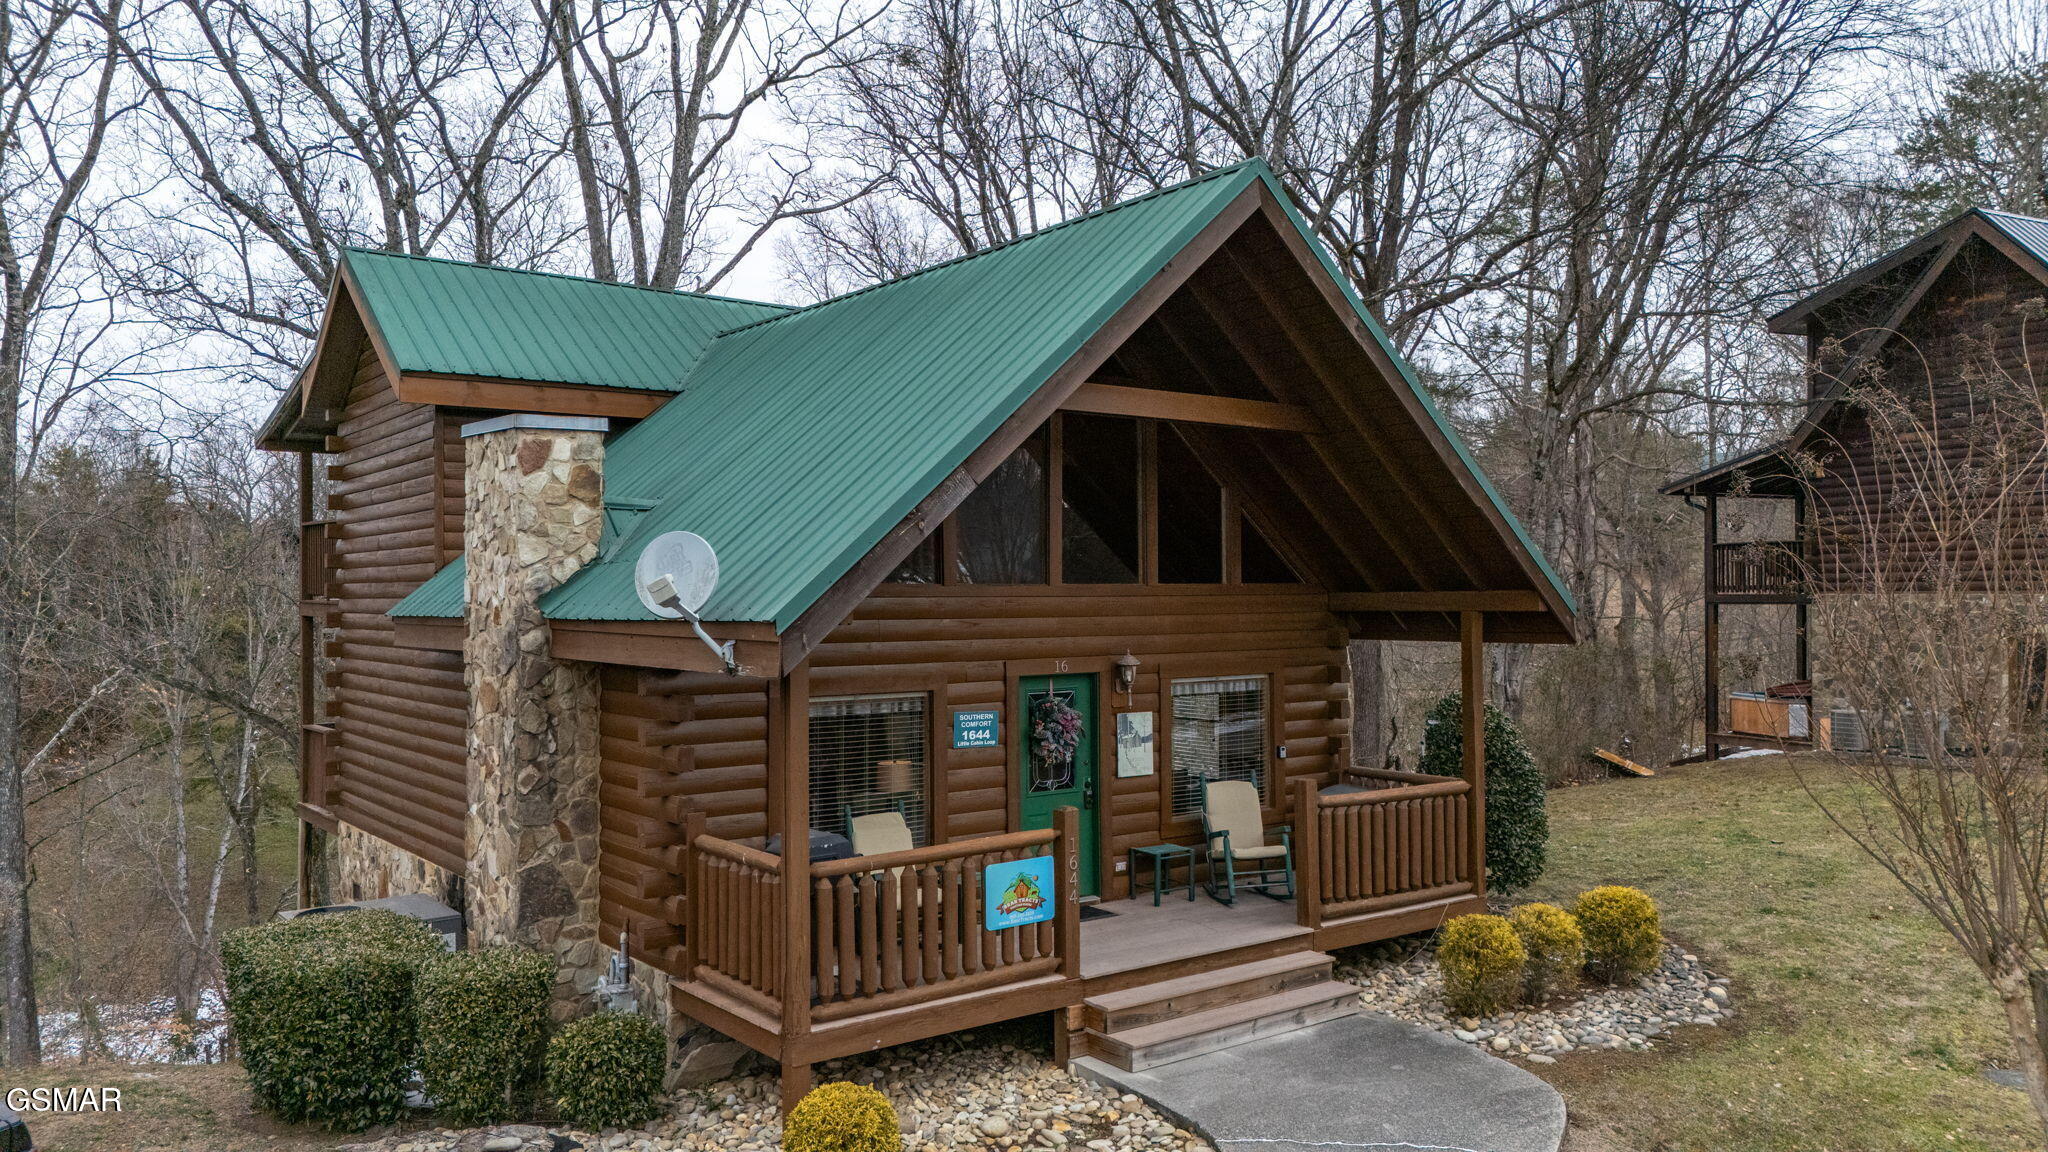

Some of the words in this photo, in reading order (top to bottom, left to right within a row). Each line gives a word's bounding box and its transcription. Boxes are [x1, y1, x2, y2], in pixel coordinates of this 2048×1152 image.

[1056, 660, 1068, 672] 16
[962, 730, 990, 740] 1644
[1069, 838, 1078, 904] 1644
